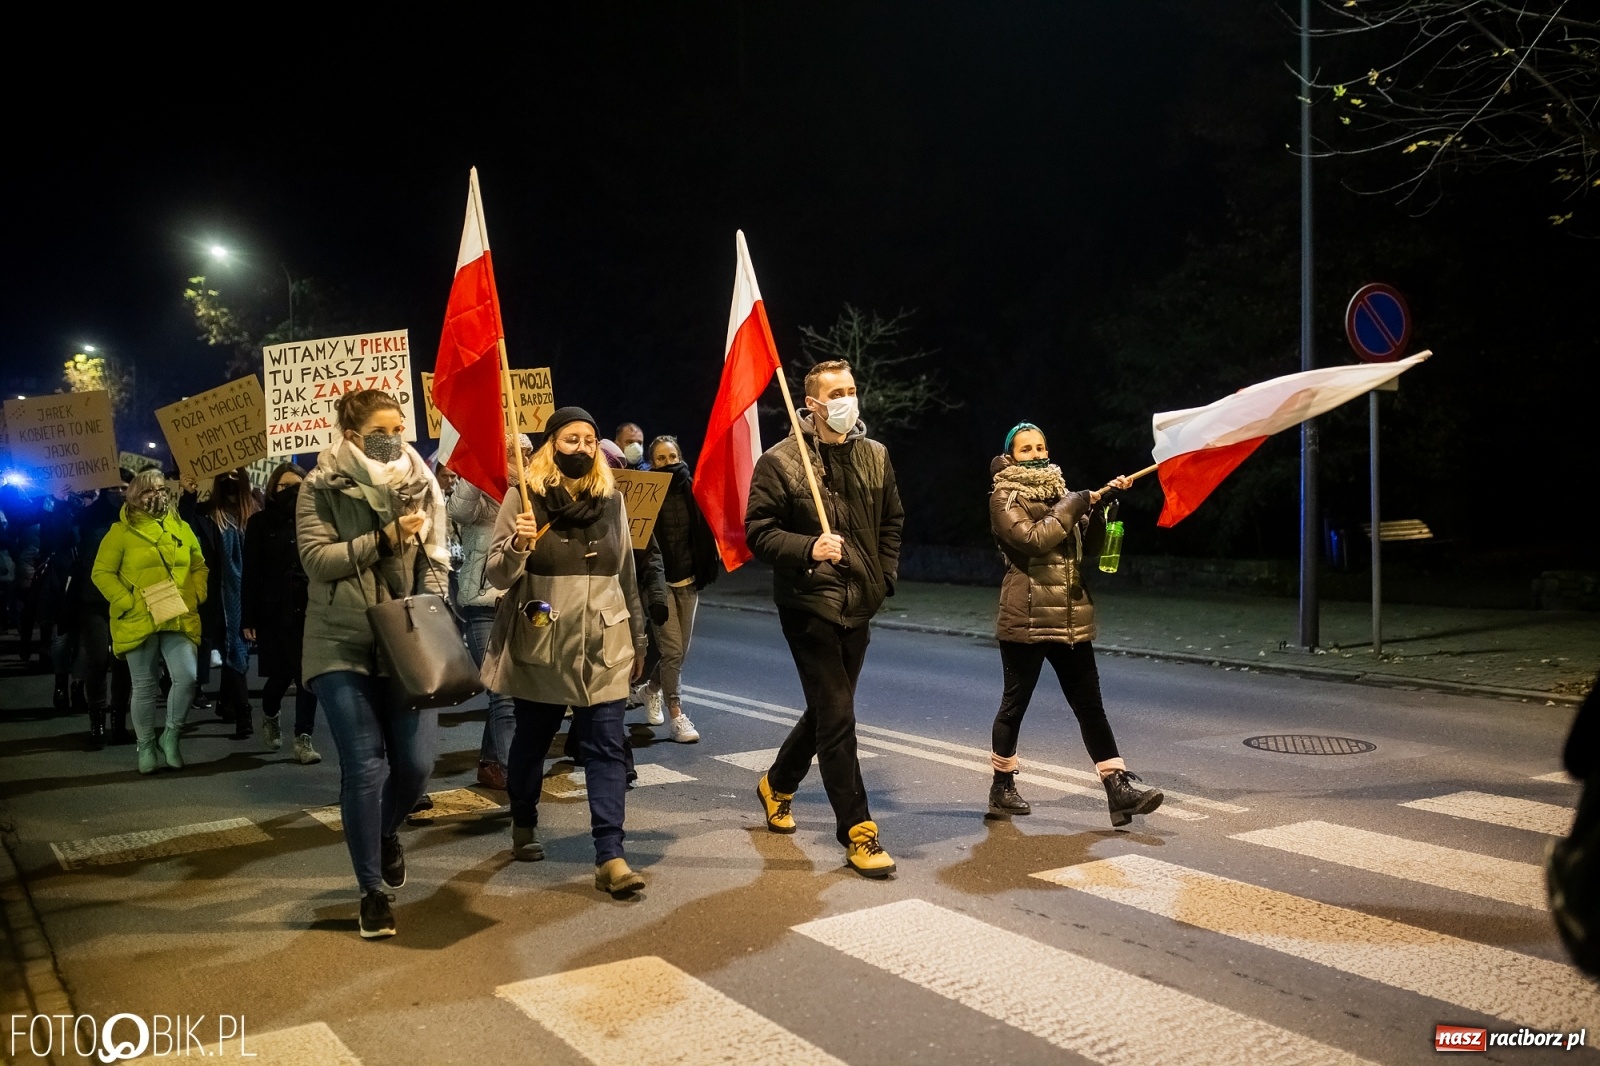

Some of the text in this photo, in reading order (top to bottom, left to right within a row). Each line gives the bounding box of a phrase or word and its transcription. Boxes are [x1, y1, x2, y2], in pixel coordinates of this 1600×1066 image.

[269, 336, 407, 367] WITAMY W PIEKLE
[269, 354, 408, 386] TU FAŁSZ JEST
[510, 372, 551, 390] TWOJA
[272, 386, 307, 406] JAK
[520, 392, 553, 406] BARDZO
[37, 405, 74, 421] JAREK
[171, 410, 206, 432] POZA
[20, 424, 65, 442] KOBIETA
[68, 421, 83, 437] TO
[85, 419, 104, 435] NIE
[196, 425, 227, 448] MAM
[269, 417, 332, 436] ZAKAZAŁ
[44, 443, 80, 459] JAJKO
[272, 434, 320, 452] MEDIA
[190, 448, 226, 477] MÓZG
[226, 444, 235, 463] I
